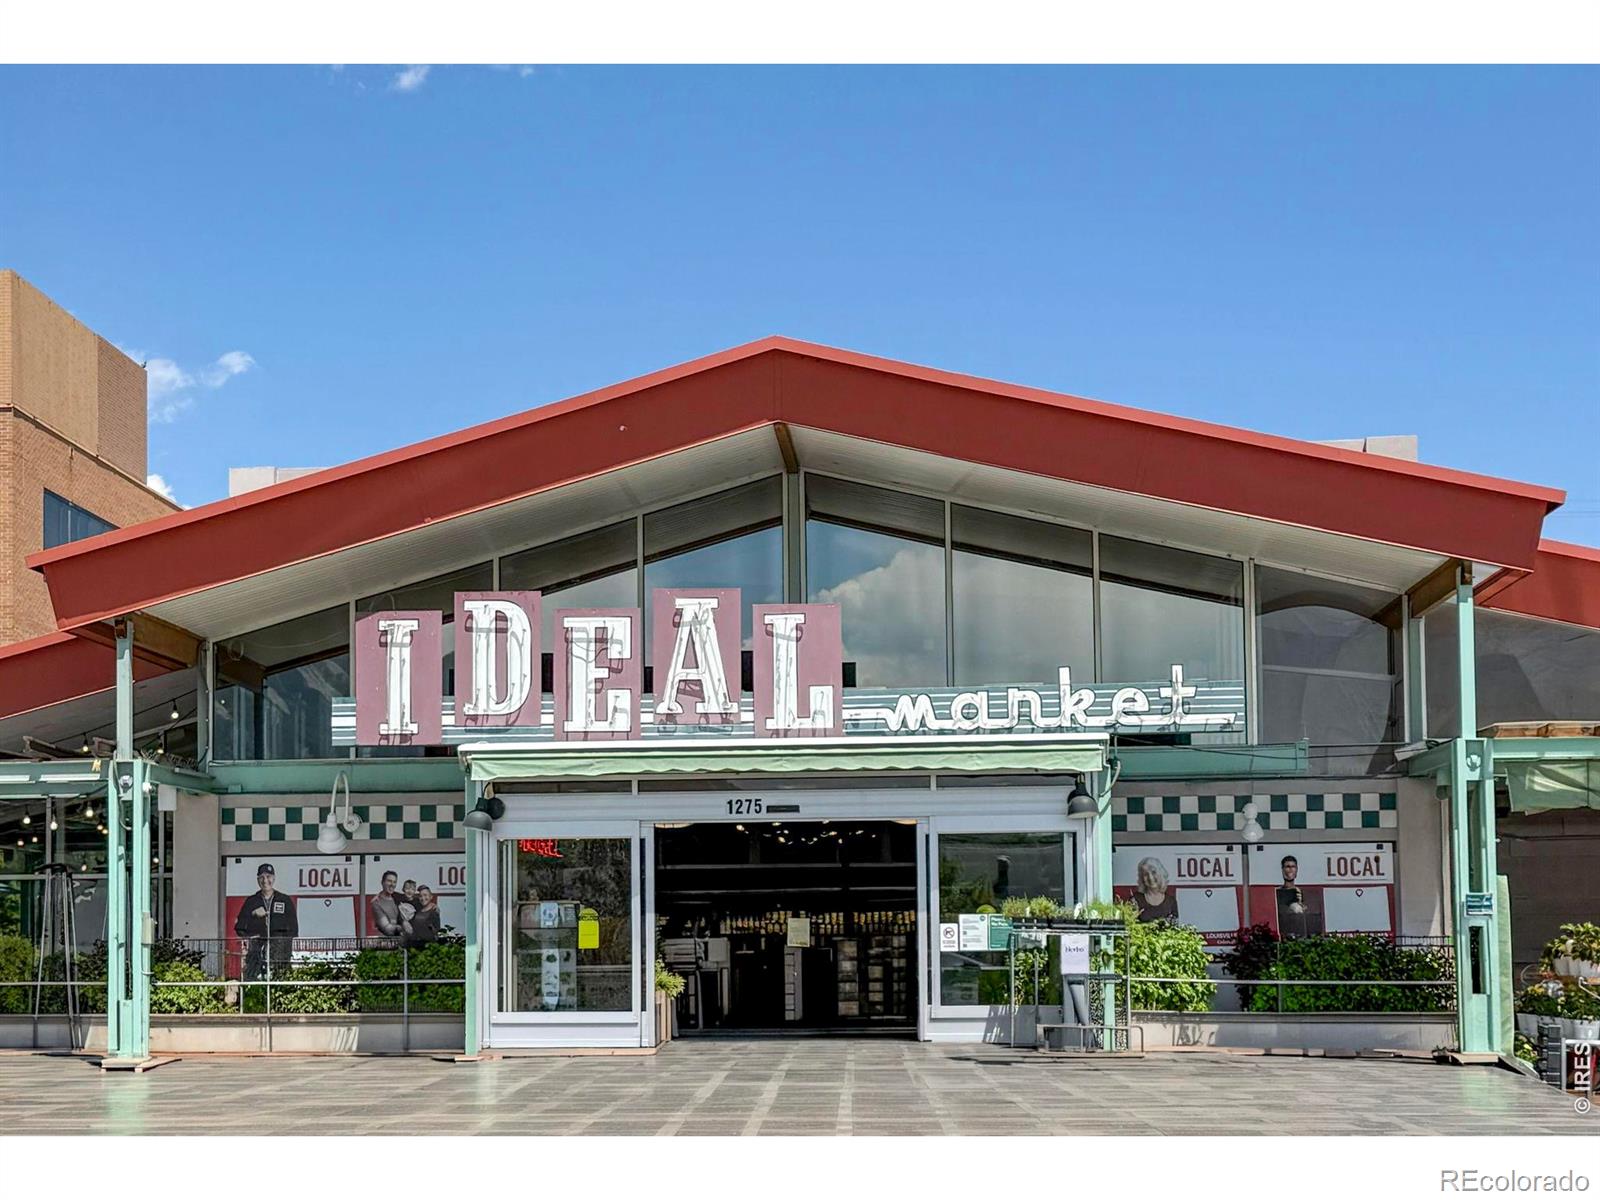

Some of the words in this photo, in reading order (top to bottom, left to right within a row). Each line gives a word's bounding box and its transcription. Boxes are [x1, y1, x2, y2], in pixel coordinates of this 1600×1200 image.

[377, 597, 834, 735] IDEAL
[846, 664, 1237, 732] market
[726, 799, 763, 815] 1275
[1177, 857, 1234, 878] LOCAL
[1326, 856, 1385, 877] LOCAL
[298, 868, 352, 888] LOCAL
